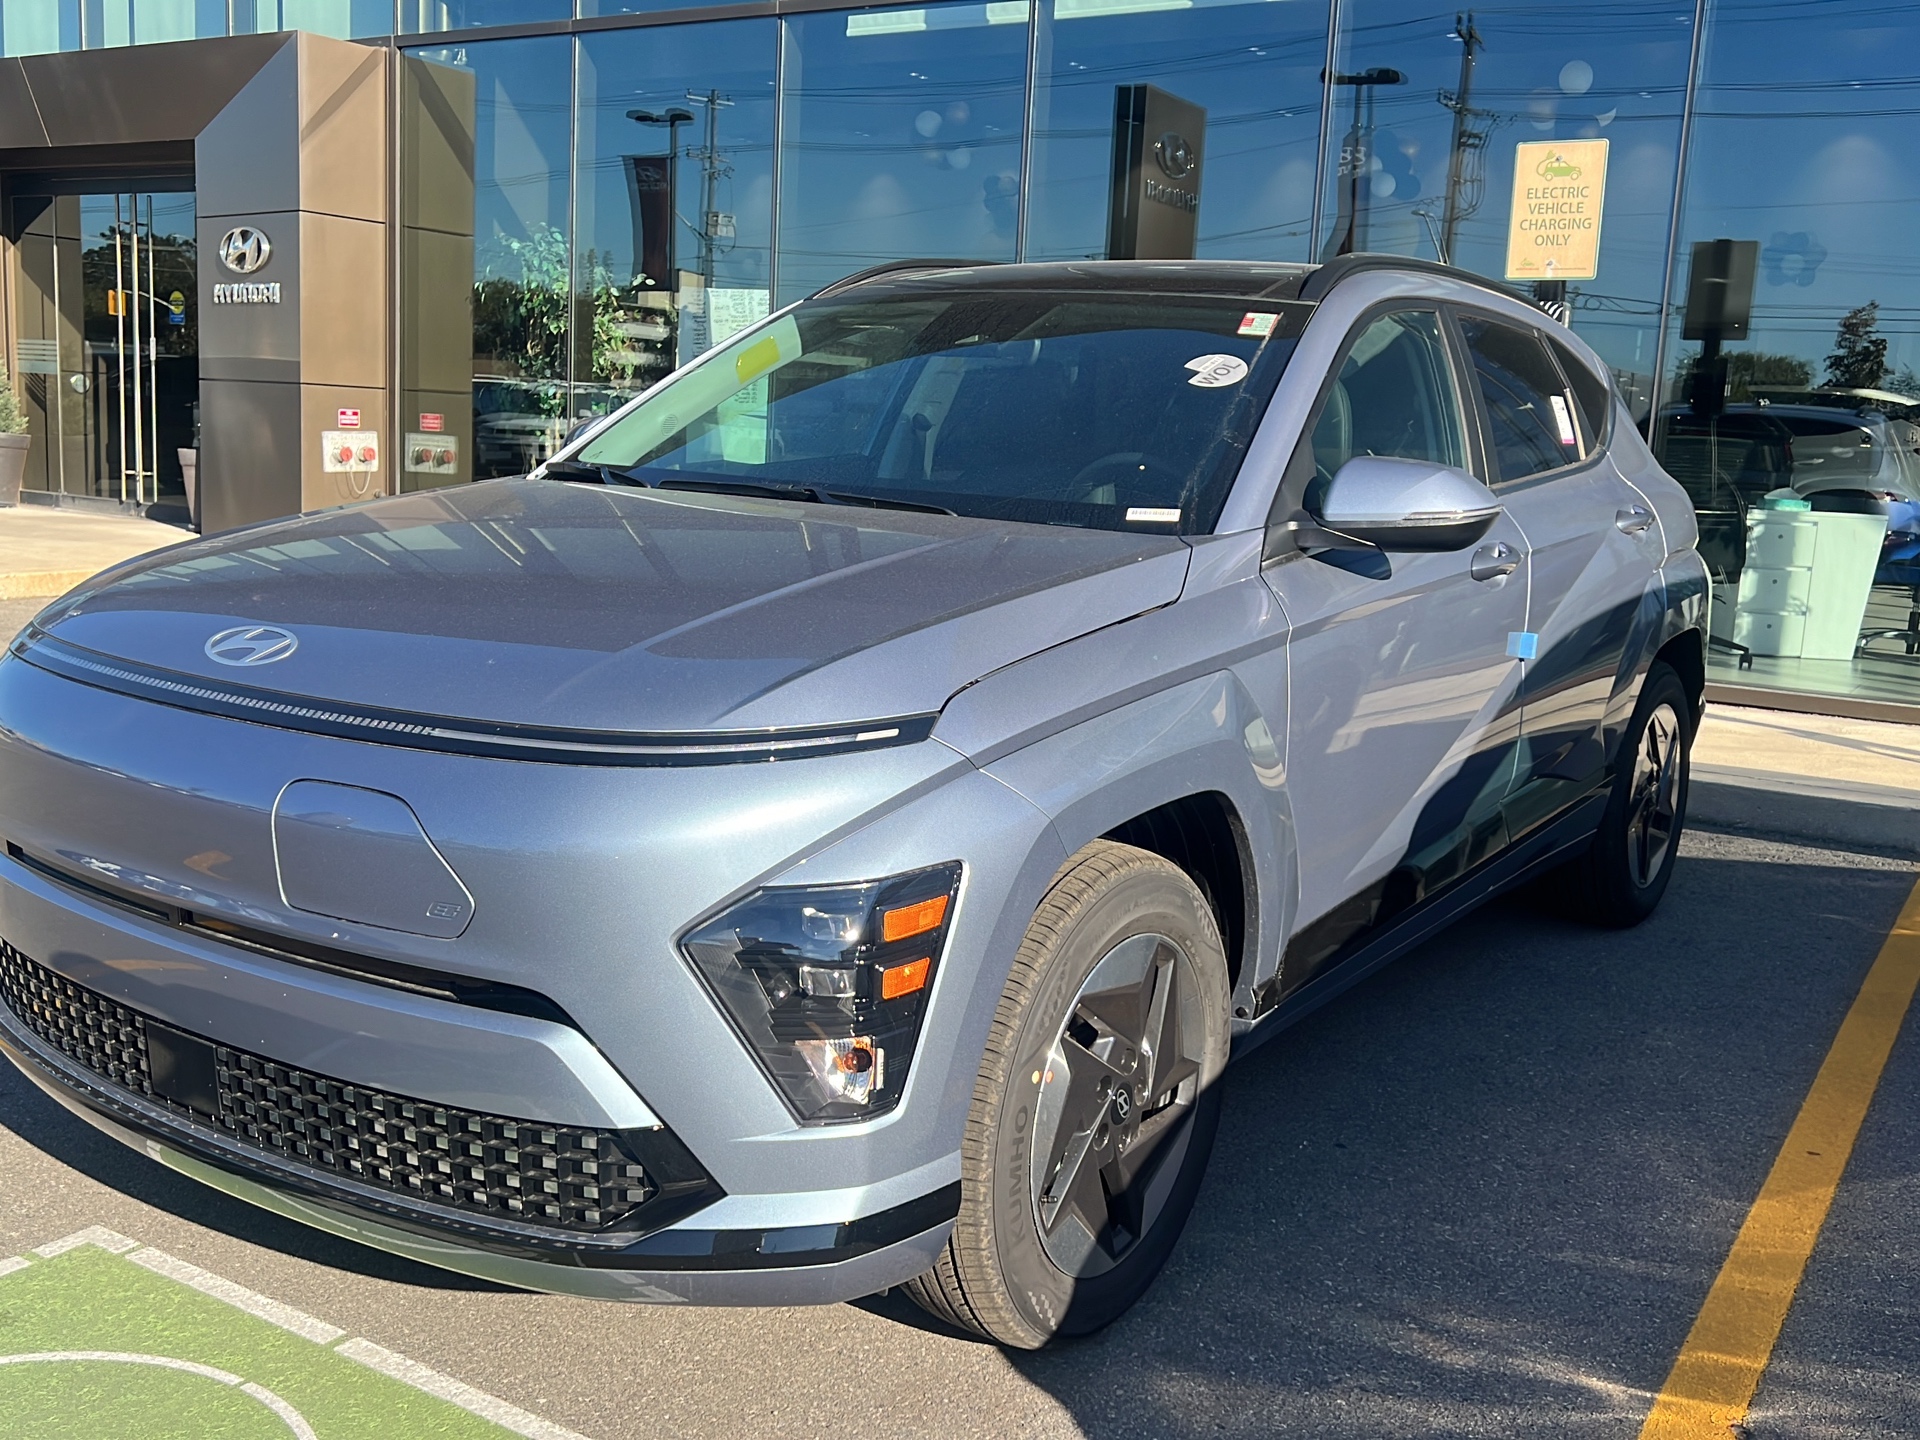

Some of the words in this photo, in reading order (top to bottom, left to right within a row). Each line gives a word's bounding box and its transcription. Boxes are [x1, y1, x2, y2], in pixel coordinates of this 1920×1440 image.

[1526, 186, 1590, 200] ELECTRIC
[1528, 202, 1584, 215] VEHICLE
[1519, 218, 1592, 231] CHARGING
[1534, 234, 1571, 247] ONLY
[213, 282, 281, 304] HYUNDAI
[1009, 1105, 1028, 1248] KUMHO
